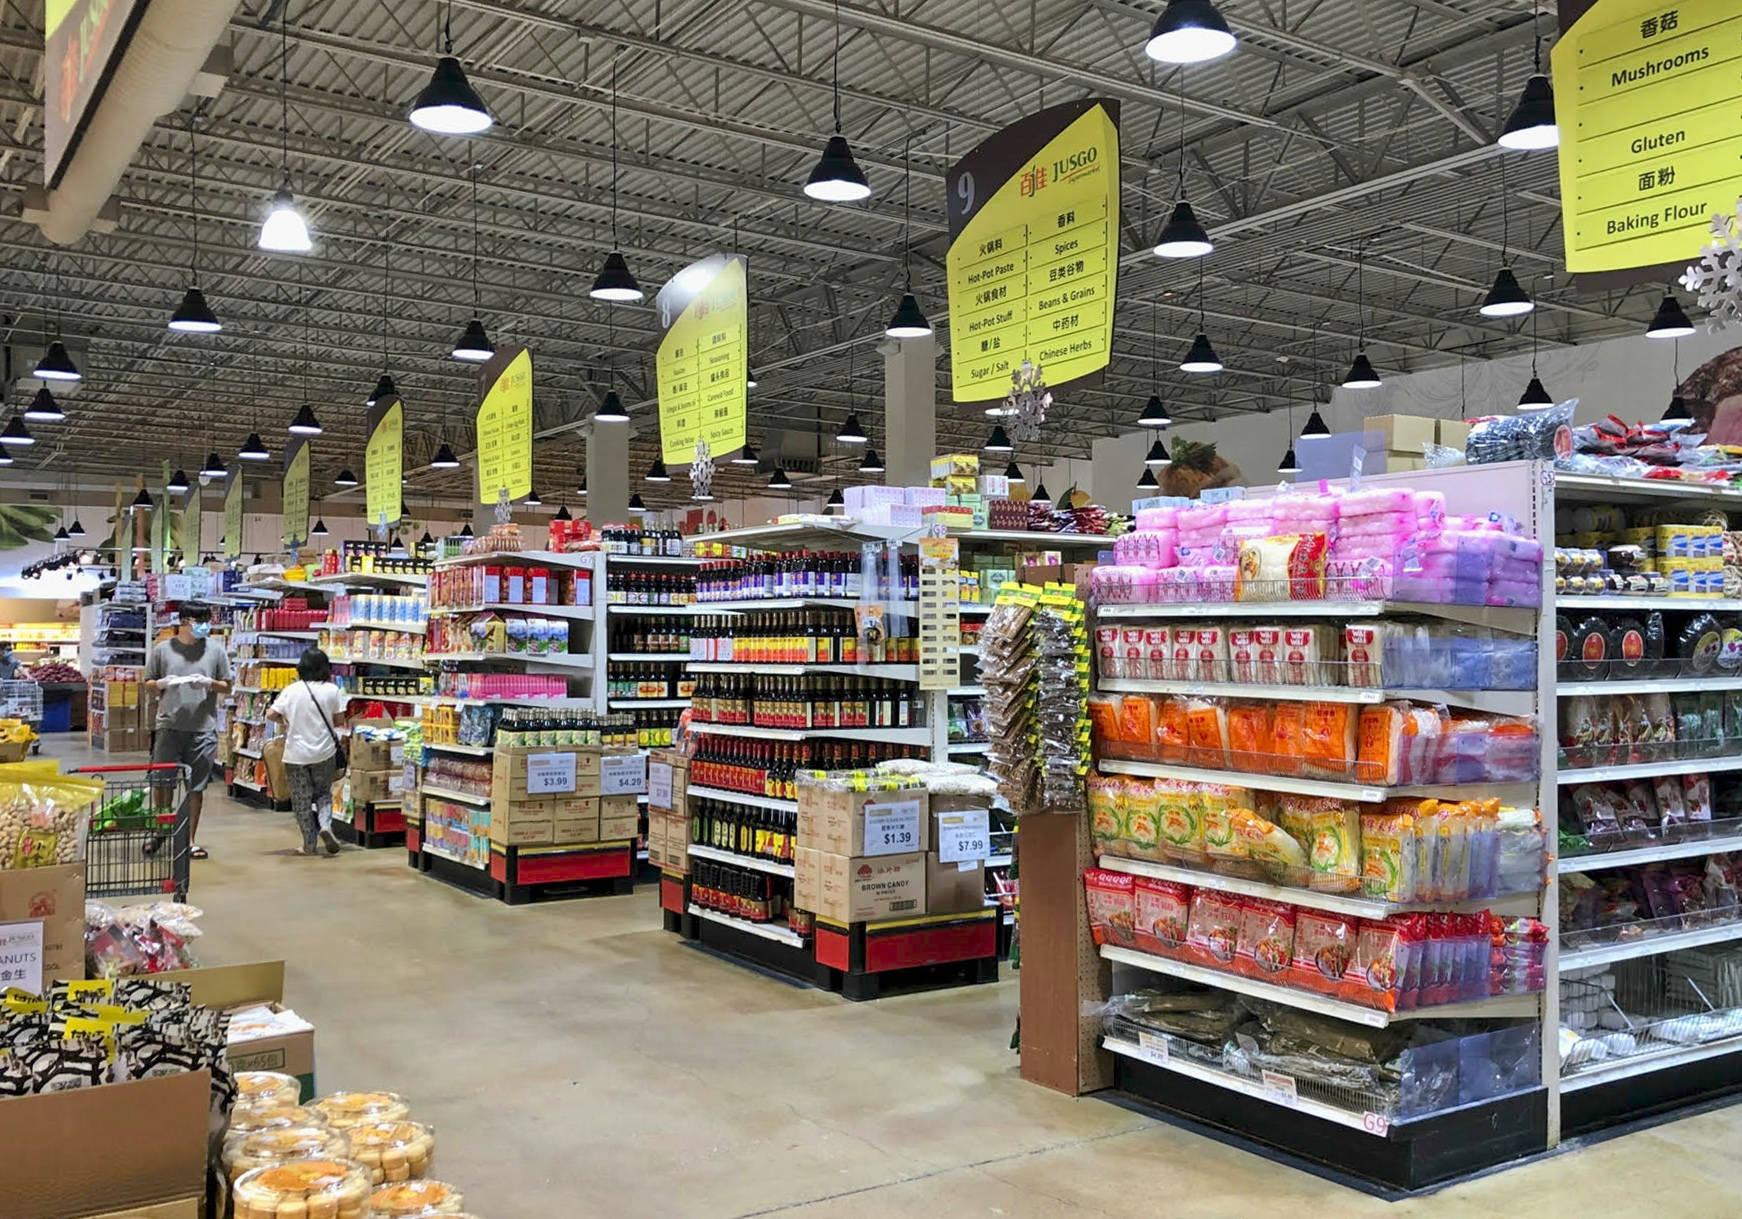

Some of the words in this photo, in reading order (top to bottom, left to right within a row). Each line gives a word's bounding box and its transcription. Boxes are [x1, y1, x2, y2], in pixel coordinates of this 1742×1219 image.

[1640, 10, 1679, 40] 香菇
[1610, 46, 1710, 88] Mushrooms
[1631, 130, 1686, 154] Gluten
[1052, 147, 1097, 182] JUSGO
[1638, 166, 1676, 191] 面粉
[958, 172, 976, 216] 9
[1606, 212, 1660, 235] Baking
[1664, 201, 1708, 222] Flour
[1054, 240, 1078, 256] Spices
[968, 268, 994, 284] Hot-Pot
[995, 262, 1014, 276] Paste
[1038, 298, 1060, 310] Beans
[1062, 293, 1068, 303] &
[1070, 287, 1095, 300] Grains
[662, 302, 671, 328] 8
[970, 316, 995, 332] Hot-Pot
[996, 310, 1013, 324] Stuff
[1040, 346, 1068, 361] Chinese
[1070, 340, 1092, 353] Herbs
[971, 367, 989, 379] Sugar
[996, 361, 1009, 372] Salt
[544, 777, 568, 786] $3.99
[884, 832, 911, 844] $1.39
[958, 840, 983, 852] $7.99
[861, 882, 886, 892] BROWN
[887, 880, 910, 888] CANDY
[1364, 1114, 1387, 1134] G9
